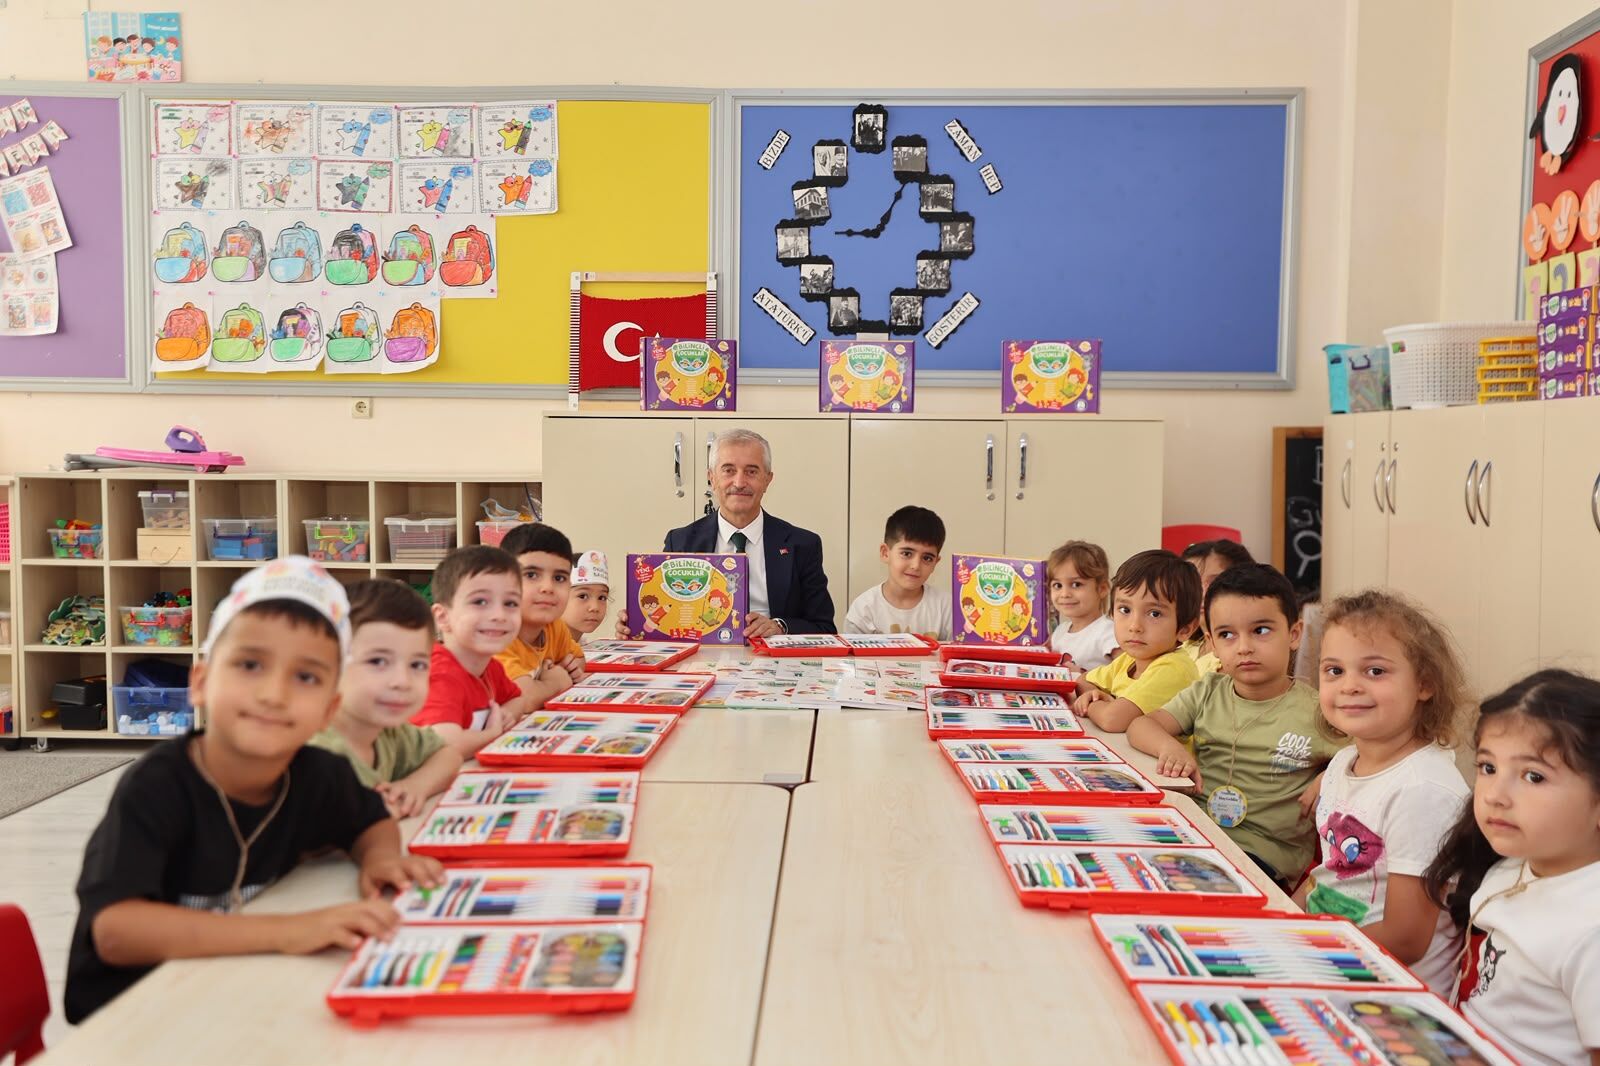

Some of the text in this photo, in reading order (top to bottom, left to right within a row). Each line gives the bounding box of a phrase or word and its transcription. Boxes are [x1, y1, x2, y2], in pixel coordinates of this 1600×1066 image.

[762, 133, 788, 167] BİZDE
[947, 121, 980, 160] ZAMAN
[982, 167, 1000, 189] HEP
[1278, 731, 1312, 749] COOL
